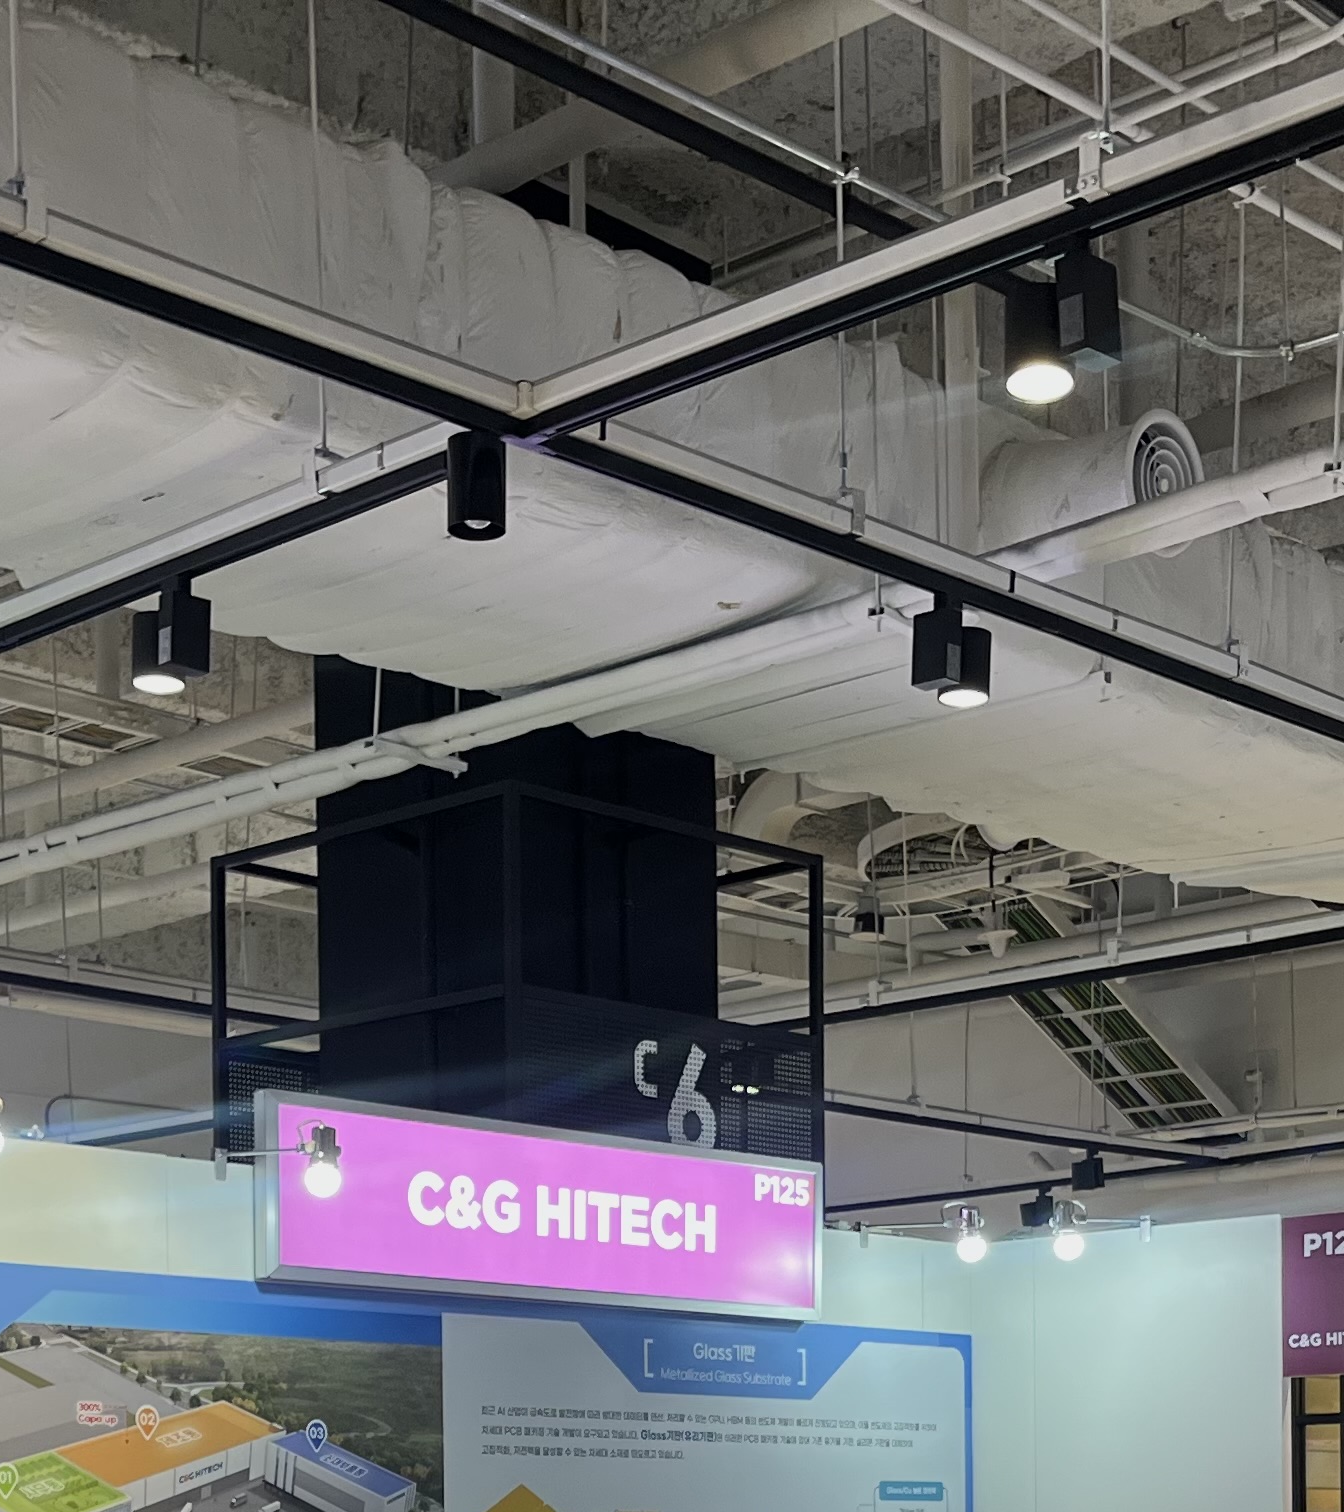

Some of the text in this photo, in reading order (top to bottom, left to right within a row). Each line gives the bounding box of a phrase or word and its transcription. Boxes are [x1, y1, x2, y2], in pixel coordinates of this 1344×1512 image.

[754, 1173, 811, 1207] P125
[407, 1170, 717, 1254] C&G HITECH
[1288, 1332, 1322, 1349] C&G
[715, 1369, 742, 1384] Glass
[743, 1371, 792, 1387] Substrate
[138, 1411, 157, 1427] 02
[308, 1425, 327, 1441] 03
